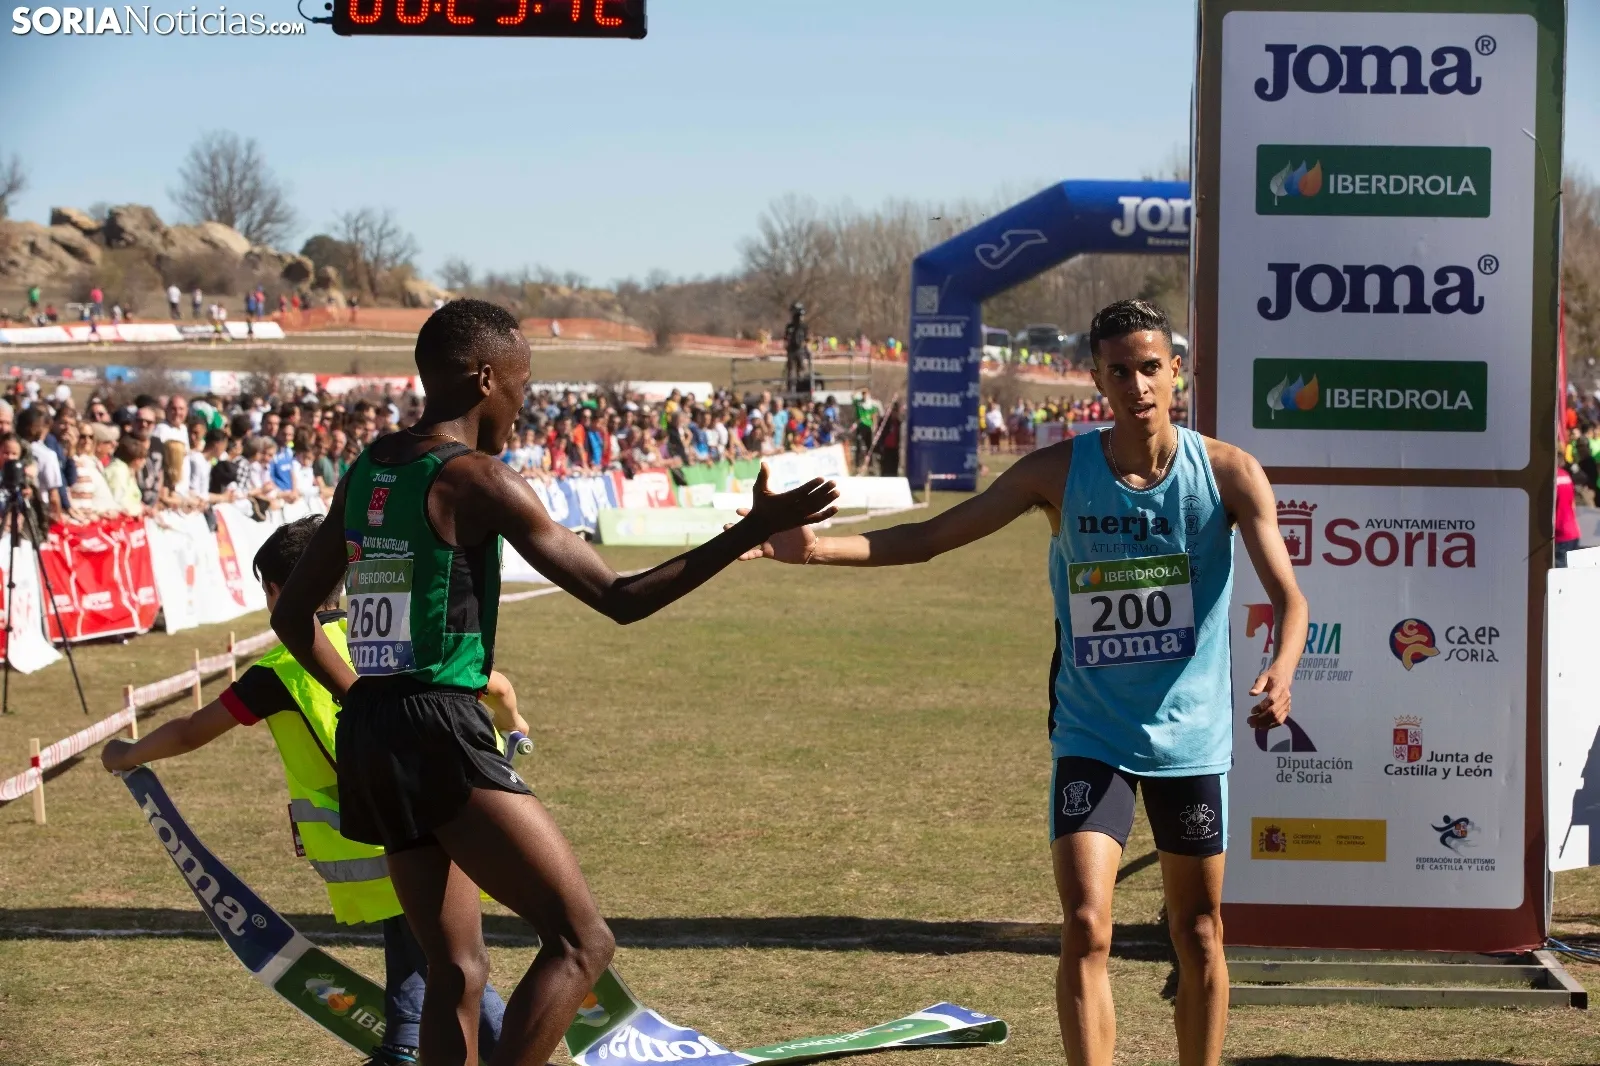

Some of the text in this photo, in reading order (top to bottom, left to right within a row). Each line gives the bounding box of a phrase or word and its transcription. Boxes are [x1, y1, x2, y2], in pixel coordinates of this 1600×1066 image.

[1329, 174, 1477, 196] IBERDROLA
[1325, 388, 1473, 410] IBERDROLA
[1078, 511, 1172, 541] nerja
[1365, 518, 1475, 530] AYUNTAMIENTO
[1090, 542, 1159, 554] ATLETISMO
[1322, 518, 1476, 568] Soria
[358, 571, 405, 585] IBERDROLA
[1104, 565, 1183, 583] IBERDROLA
[350, 597, 392, 638] 260
[1090, 590, 1172, 632] 200
[1297, 657, 1339, 669] EUROPEAN
[1294, 669, 1353, 682] CITY OF SPORT
[1277, 756, 1353, 772] Diputación
[1426, 751, 1493, 763] Junta de
[1276, 771, 1332, 784] de Soria
[1384, 764, 1493, 780] Castilla y León
[1416, 856, 1453, 864] FEDERACIÓN
